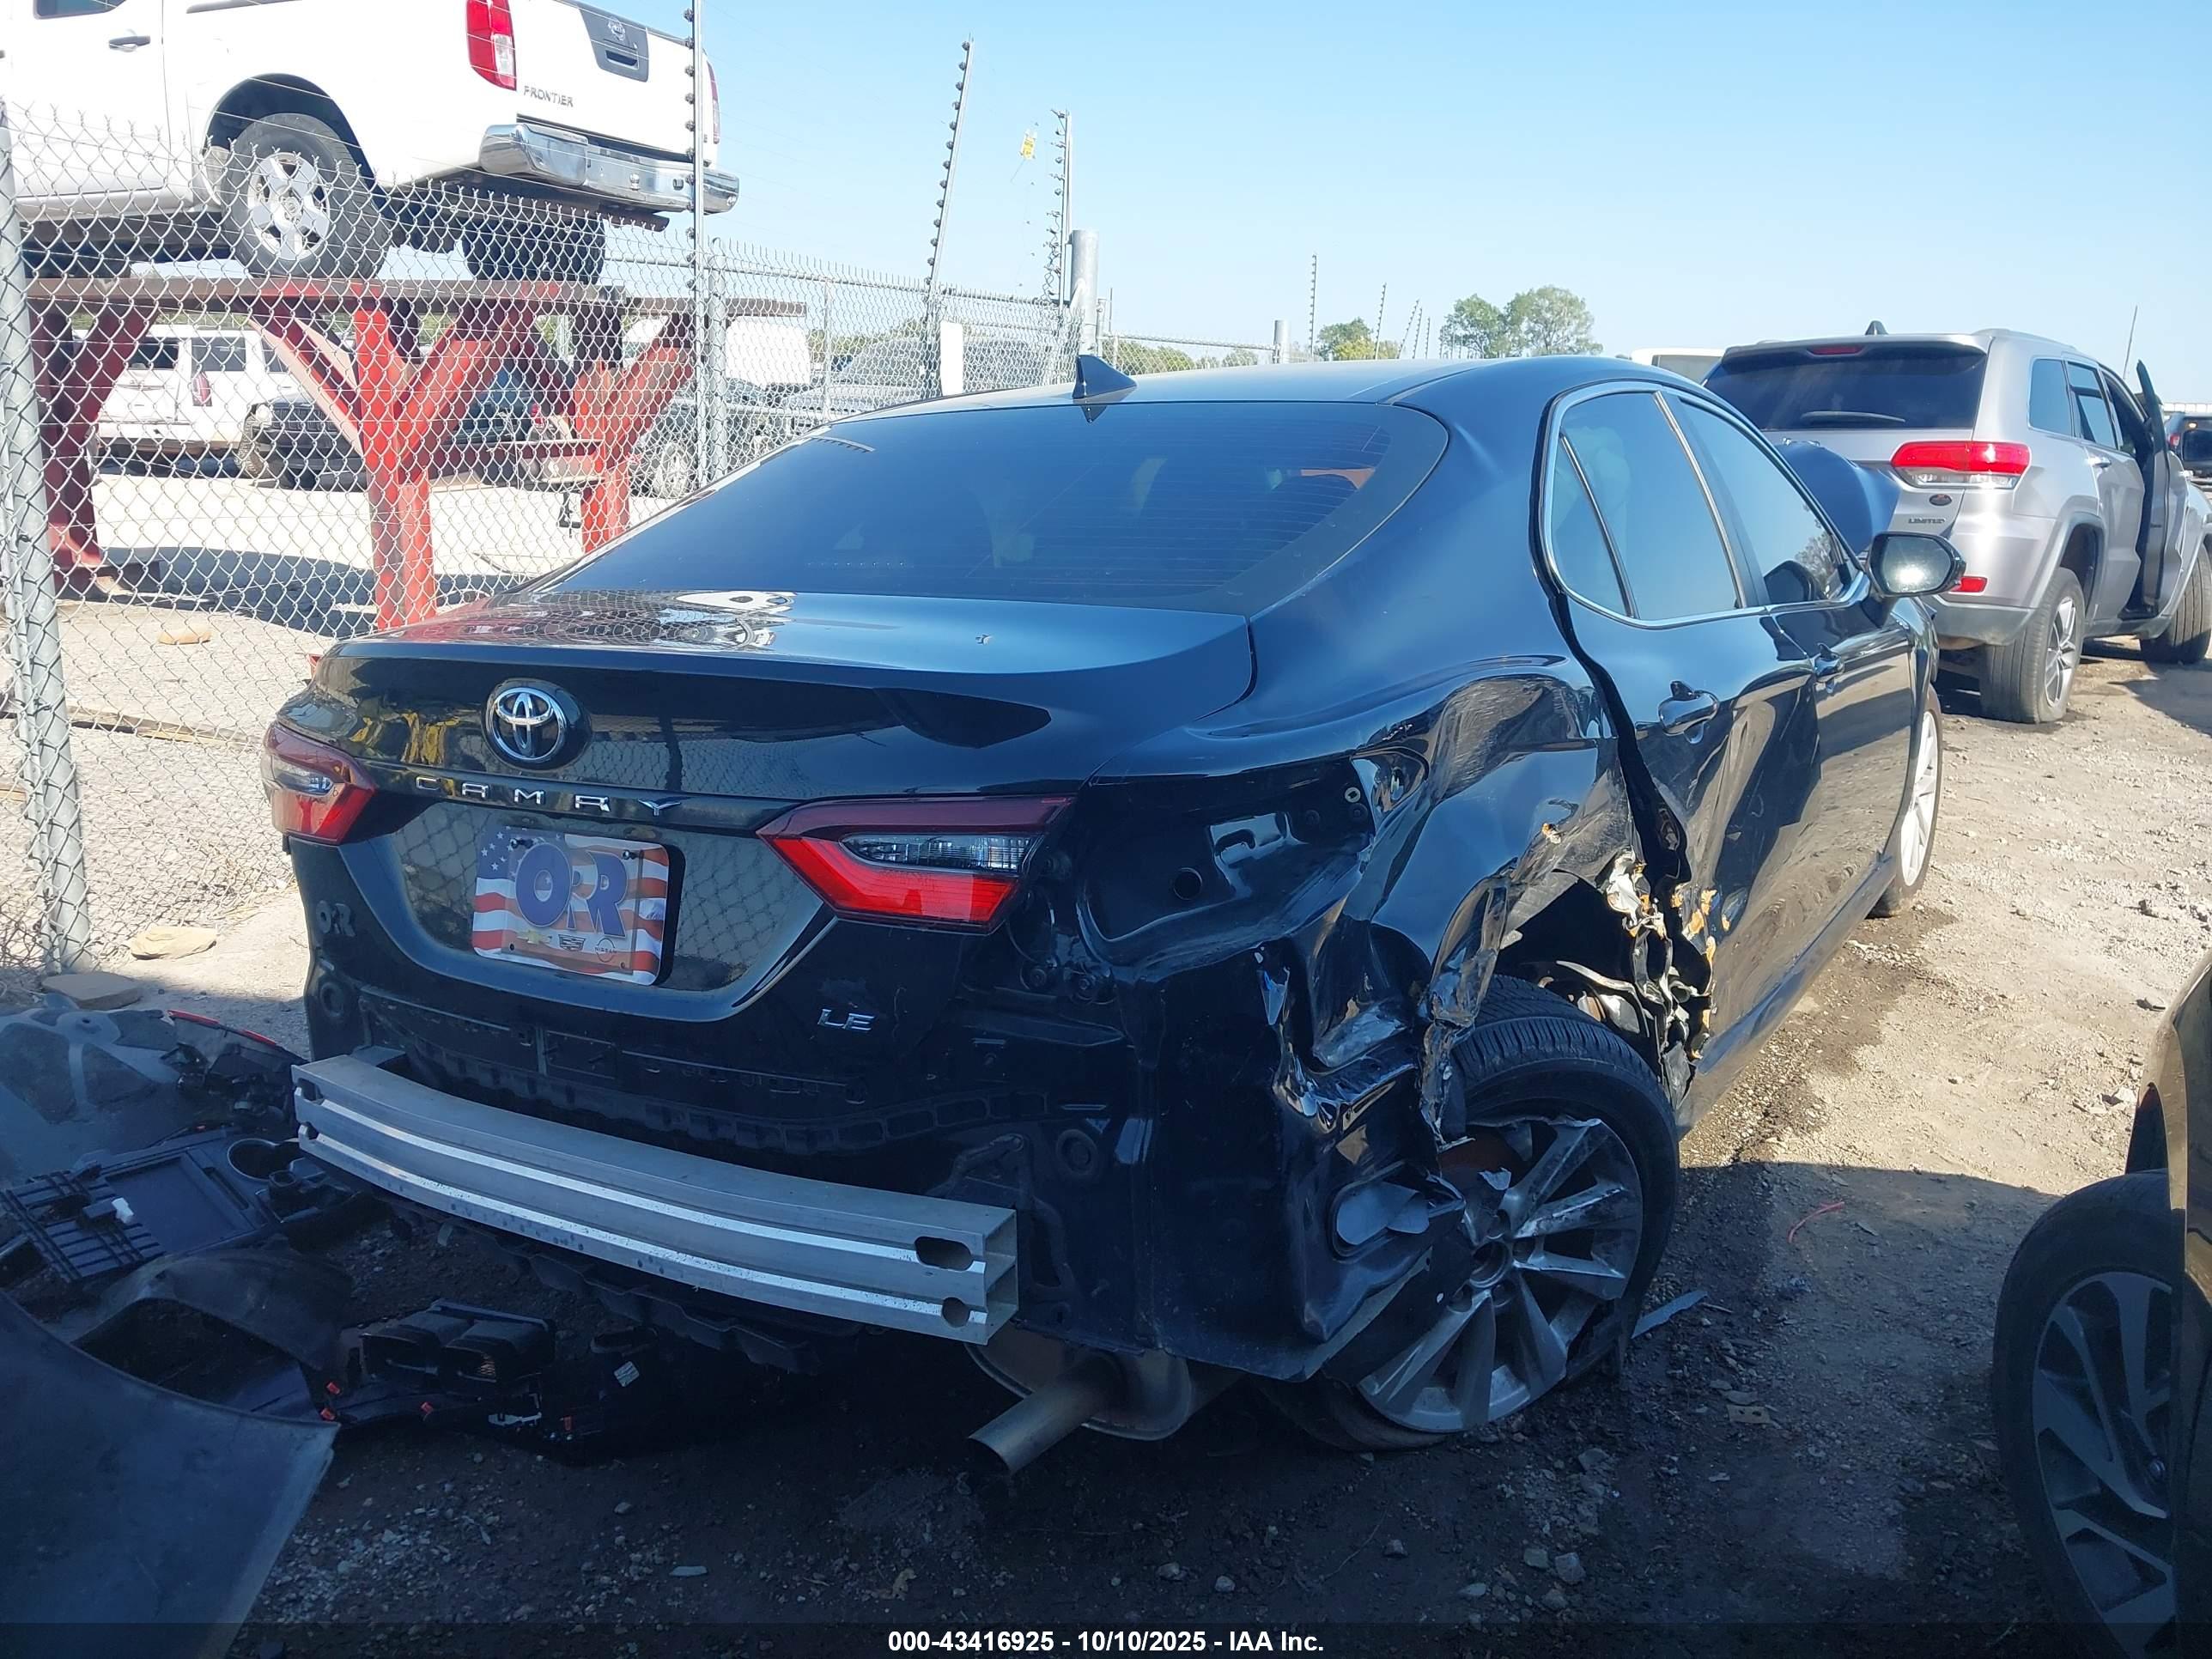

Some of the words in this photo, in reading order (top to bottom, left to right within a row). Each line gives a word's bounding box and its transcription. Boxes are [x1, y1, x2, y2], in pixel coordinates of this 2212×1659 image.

[523, 85, 574, 107] FRONTIER
[416, 775, 682, 816] CAMRY
[817, 1008, 875, 1032] LE
